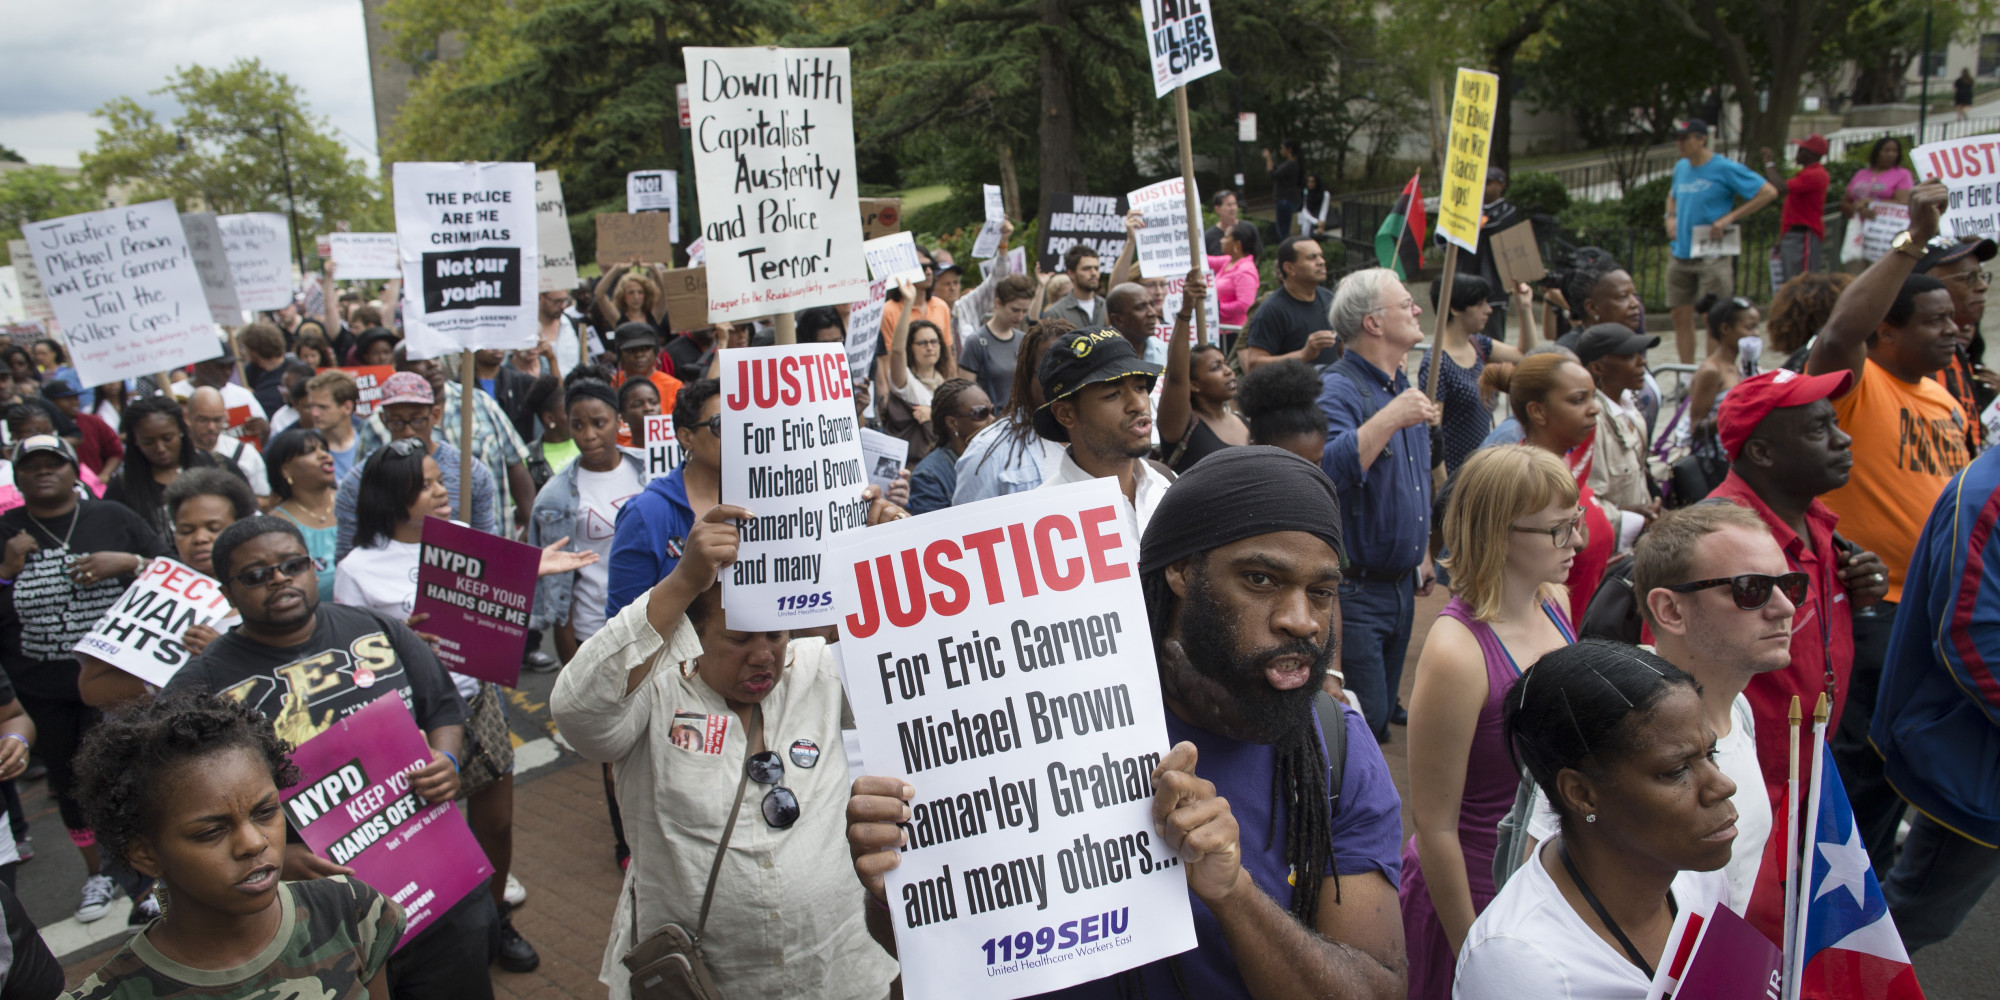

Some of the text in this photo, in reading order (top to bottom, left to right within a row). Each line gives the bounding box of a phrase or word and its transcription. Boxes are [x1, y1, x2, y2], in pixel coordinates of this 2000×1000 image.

[1169, 37, 1214, 75] COPS
[702, 57, 842, 104] Down With
[699, 107, 816, 163] Capitalist
[734, 152, 840, 199] Austerity
[1132, 180, 1186, 205] JUSTIC
[426, 191, 512, 205] THE POLICE
[1073, 194, 1117, 215] WHITE
[1949, 184, 1992, 210] or Eric
[40, 210, 151, 250] Justice for
[441, 211, 473, 225] ARE
[706, 198, 820, 242] and Police
[1050, 212, 1127, 233] NEIGHBORS
[1950, 214, 1996, 237] Michael
[45, 241, 114, 276] Michael
[120, 235, 172, 257] Brown
[48, 276, 81, 297] and
[82, 267, 119, 290] Eric
[122, 245, 187, 280] Garner!
[436, 257, 508, 278] Not our
[738, 238, 832, 283] Terror!
[82, 285, 166, 319] Jail the
[441, 280, 502, 307] youth!
[711, 298, 739, 312] League
[741, 291, 750, 304] for
[64, 322, 121, 347] Killer
[129, 302, 180, 333] Cops!
[727, 352, 852, 411] JUSTICE
[649, 418, 677, 442] RE
[743, 422, 776, 455] For
[782, 415, 815, 452] Eric
[818, 414, 853, 448] Garner
[748, 457, 863, 500] Michael Brown
[736, 506, 823, 543] Ramarley
[424, 545, 482, 578] NYPD
[733, 553, 821, 586] and many
[845, 505, 1131, 639] JUSTICE
[138, 560, 225, 609] PECT
[455, 576, 527, 610] KEEP YOUR
[777, 590, 833, 611] 1199S
[427, 584, 527, 626] HANDS OFF ME
[777, 605, 828, 618] United Healthcare
[877, 611, 1123, 705] For Eric Garner
[897, 682, 1135, 775] Michael Brown
[289, 764, 364, 828] NYPD
[345, 784, 386, 823] KEEP
[899, 751, 1162, 853] Ramarley Graham
[330, 793, 416, 866] HANDS OFF
[422, 816, 432, 825] to
[902, 830, 1179, 929] and many others...
[981, 906, 1129, 966] 1199SEIU
[986, 934, 1132, 977] United Healthcare Workers East
